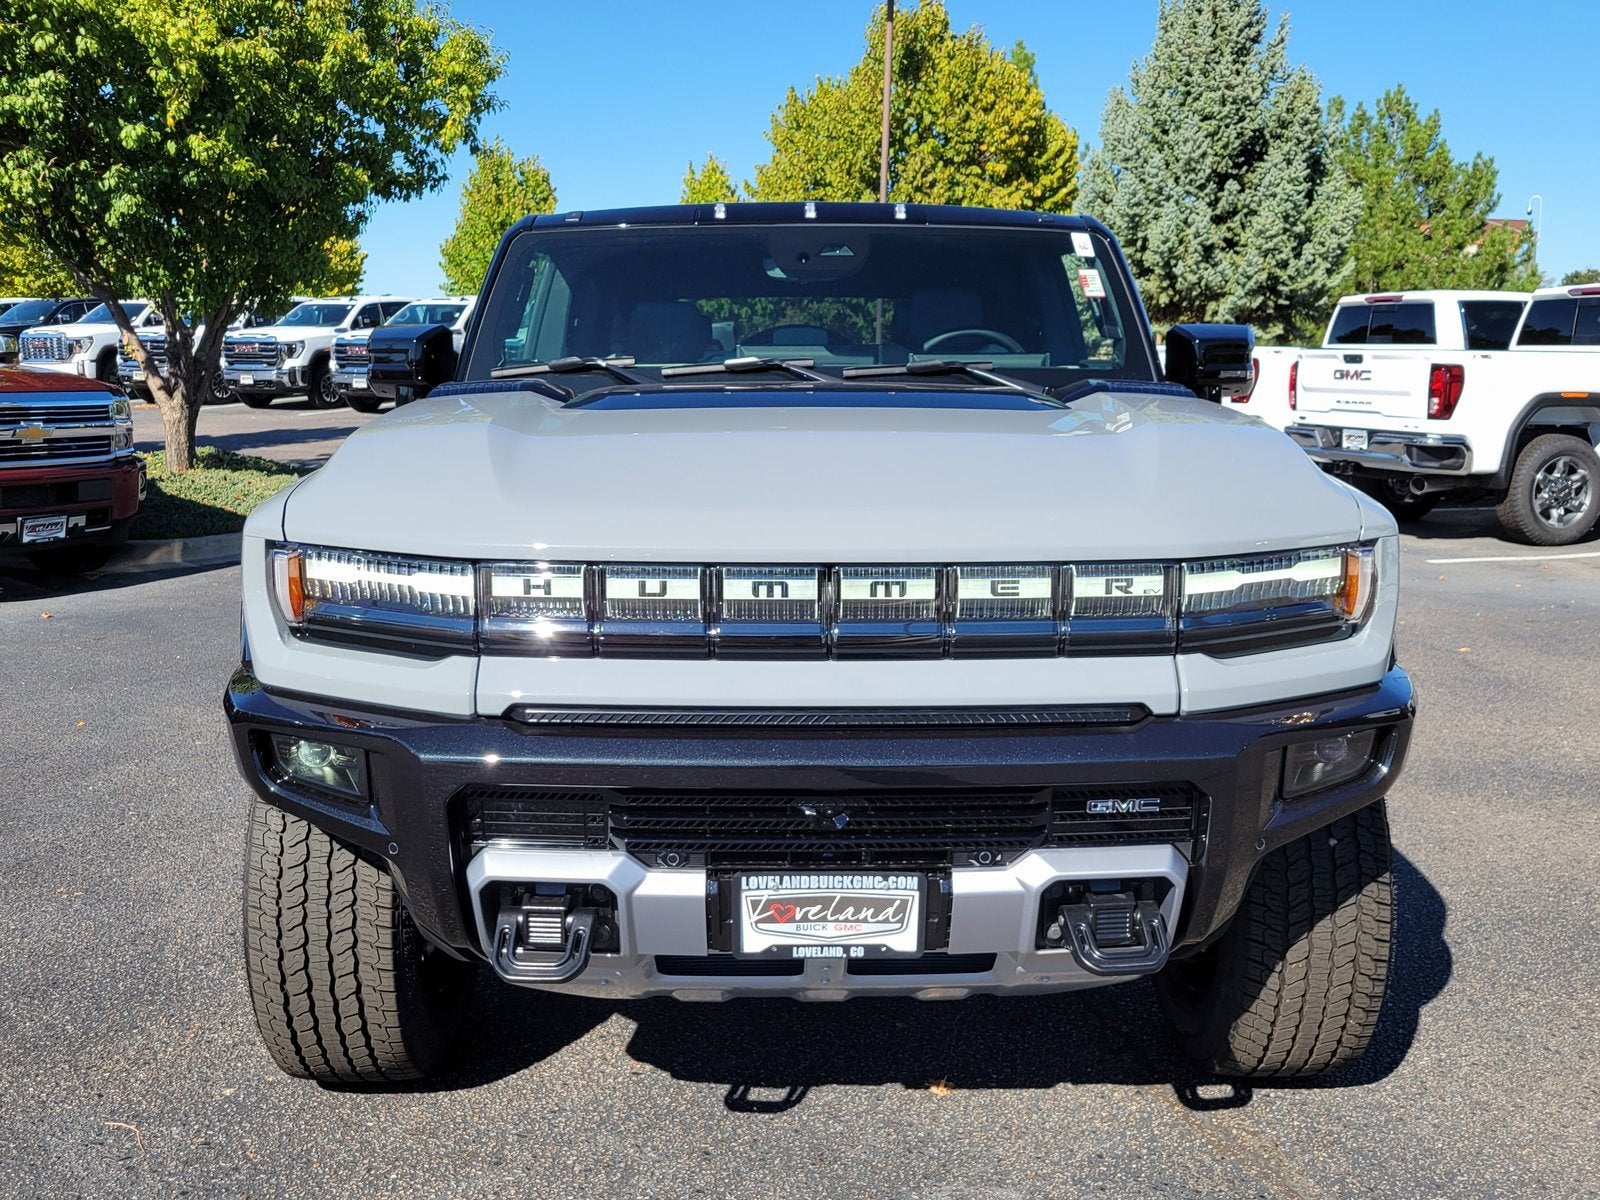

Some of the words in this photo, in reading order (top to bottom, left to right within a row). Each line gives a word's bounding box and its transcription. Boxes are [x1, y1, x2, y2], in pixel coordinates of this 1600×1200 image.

[1333, 369, 1372, 381] GMC
[1086, 798, 1160, 814] GMC
[795, 923, 829, 932] BUICK
[833, 923, 863, 932] GMC
[792, 946, 847, 958] LOVELAND,
[850, 946, 865, 958] CO
